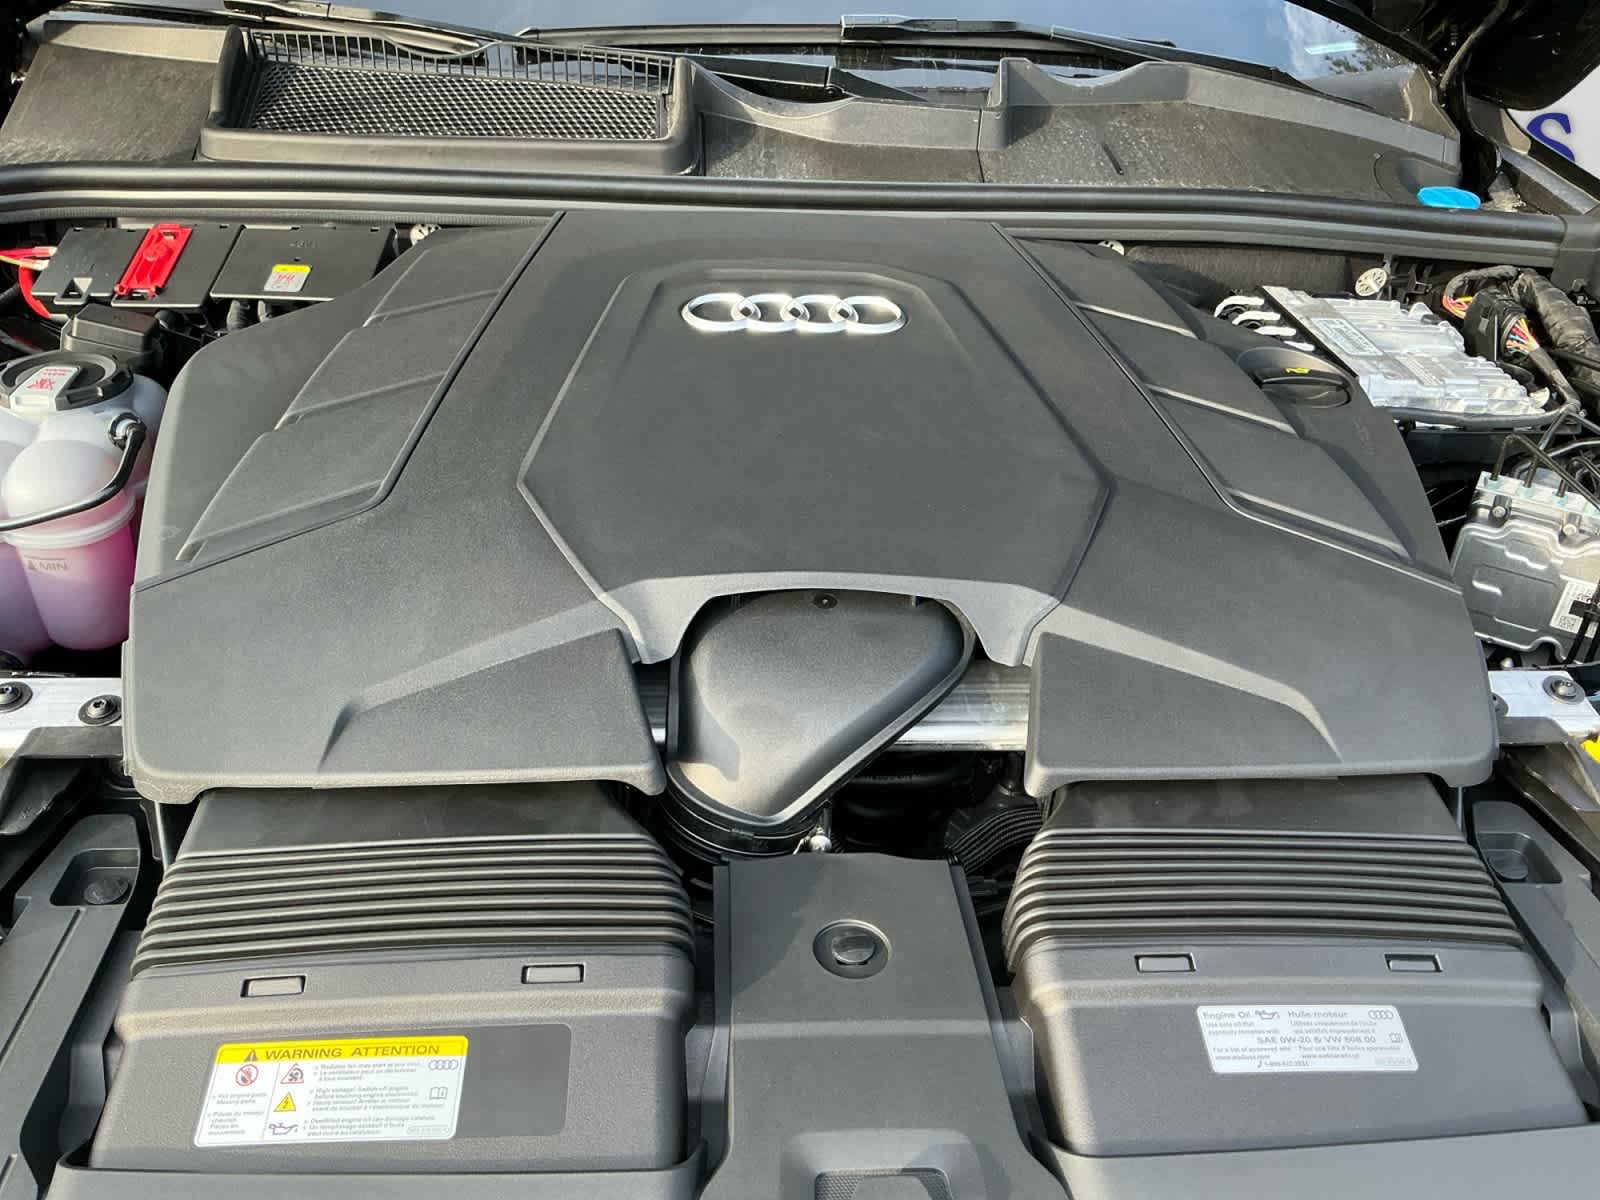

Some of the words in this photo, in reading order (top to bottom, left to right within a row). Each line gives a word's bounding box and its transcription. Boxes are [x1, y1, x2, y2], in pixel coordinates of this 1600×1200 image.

[1202, 1010, 1236, 1020] Engine
[1238, 1010, 1250, 1018] Oil
[1288, 1010, 1311, 1018] Huile
[1313, 1010, 1349, 1018] moteur
[1256, 1036, 1277, 1044] SAE
[1279, 1035, 1312, 1043] 0W-20
[1323, 1035, 1342, 1043] VW
[264, 1047, 343, 1060] WARNING
[350, 1044, 441, 1057] ATTENTION
